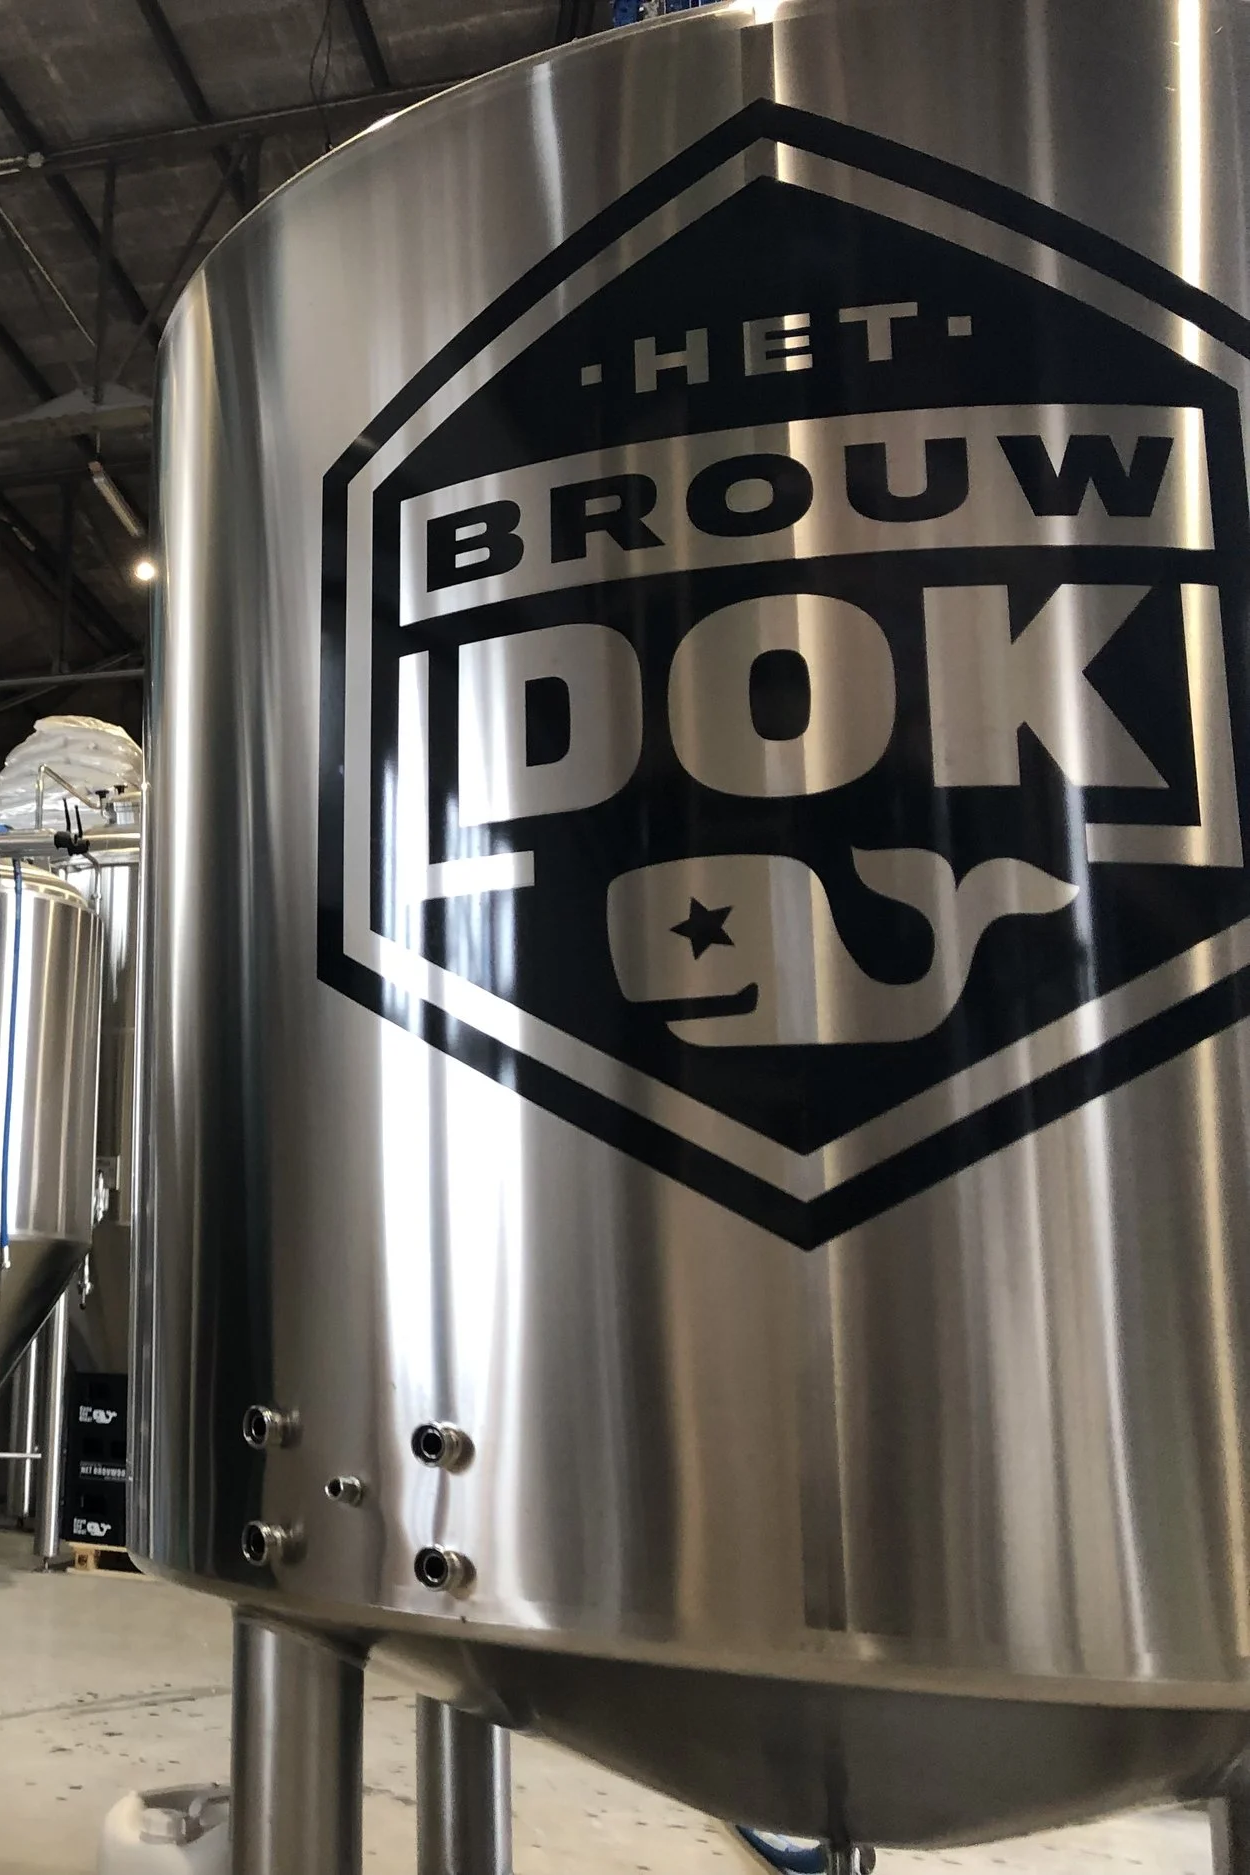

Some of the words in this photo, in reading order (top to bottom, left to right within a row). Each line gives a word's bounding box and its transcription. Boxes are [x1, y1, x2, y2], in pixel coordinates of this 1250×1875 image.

[633, 302, 918, 393] HET
[426, 435, 1174, 593] BROUW
[458, 584, 1169, 828] DOK
